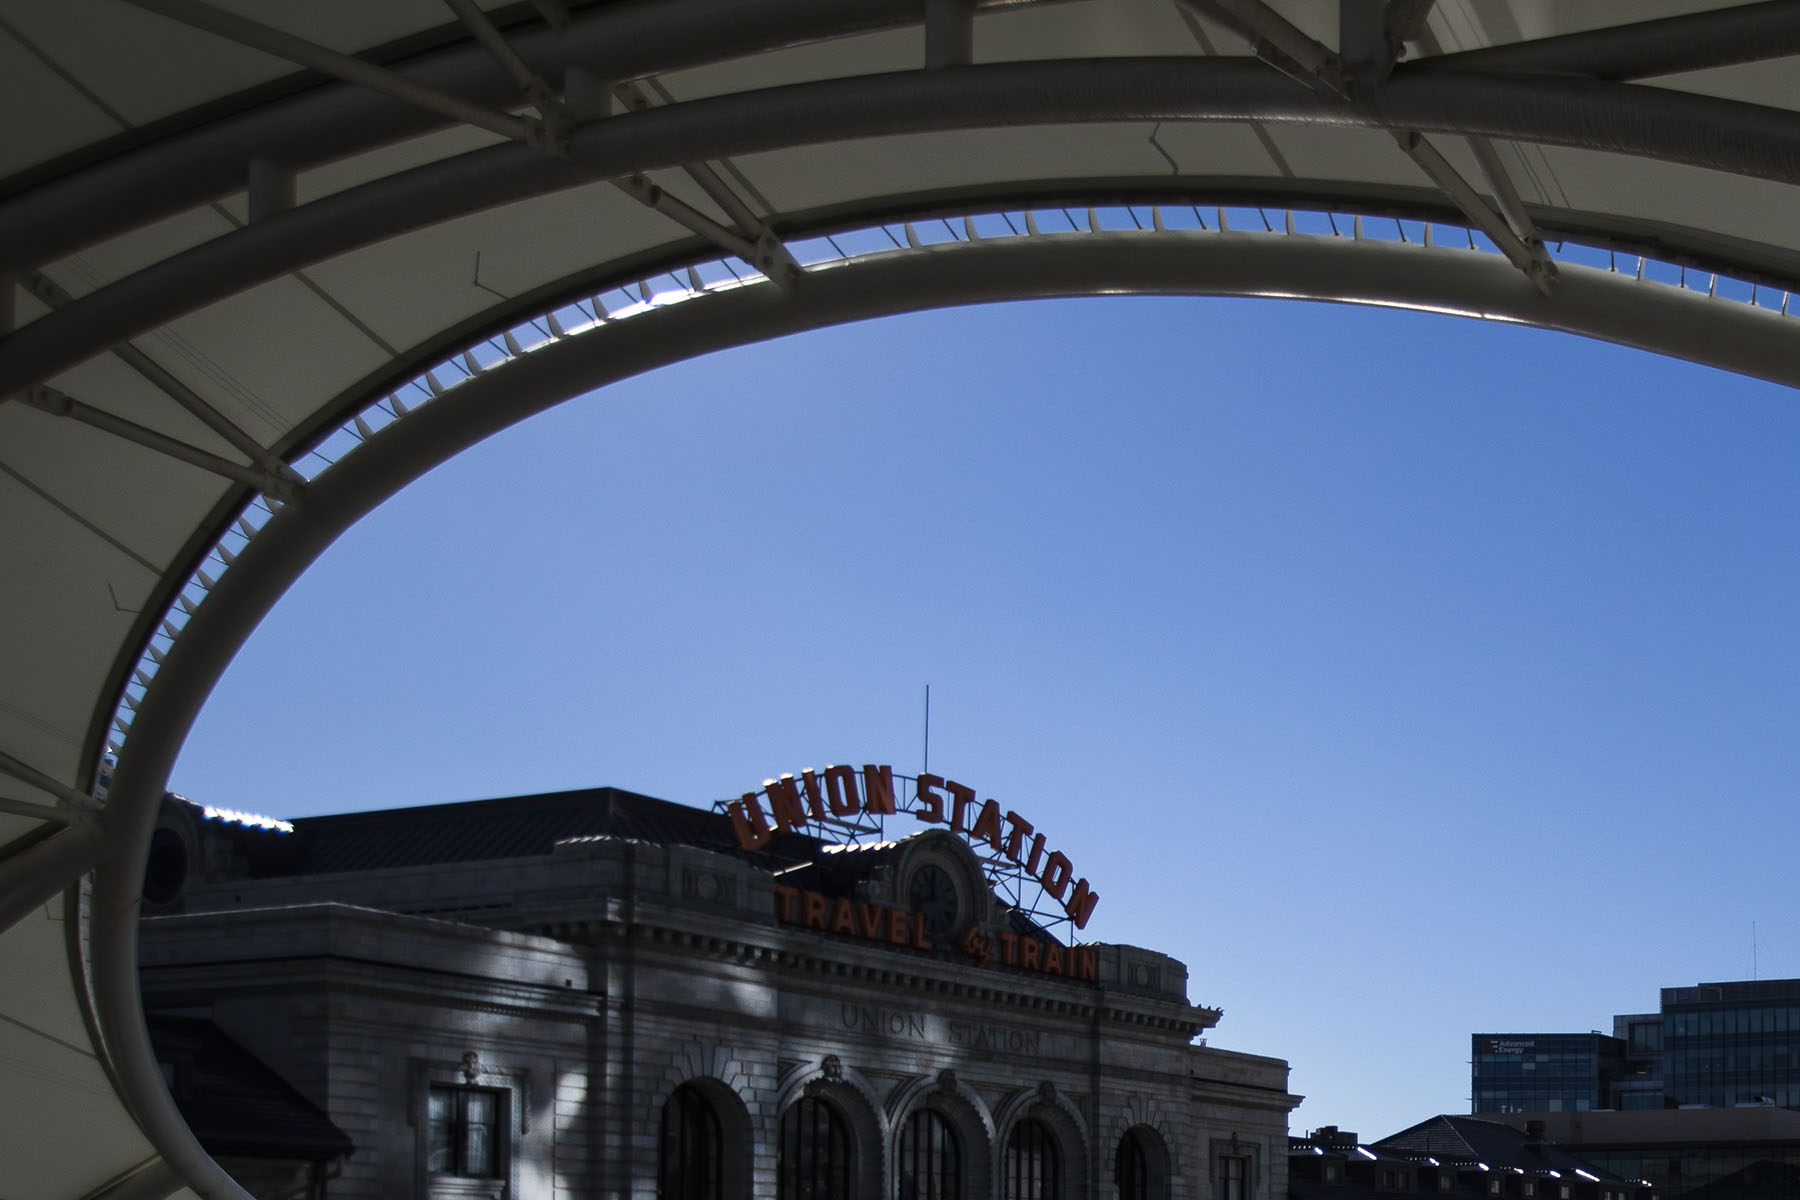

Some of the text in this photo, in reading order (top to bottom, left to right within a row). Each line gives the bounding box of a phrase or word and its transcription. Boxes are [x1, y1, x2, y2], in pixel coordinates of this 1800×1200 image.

[727, 764, 1100, 930] UNION STATION
[776, 884, 1099, 982] TRAVEL by TRAIN
[841, 1003, 1041, 1054] UNION STATION
